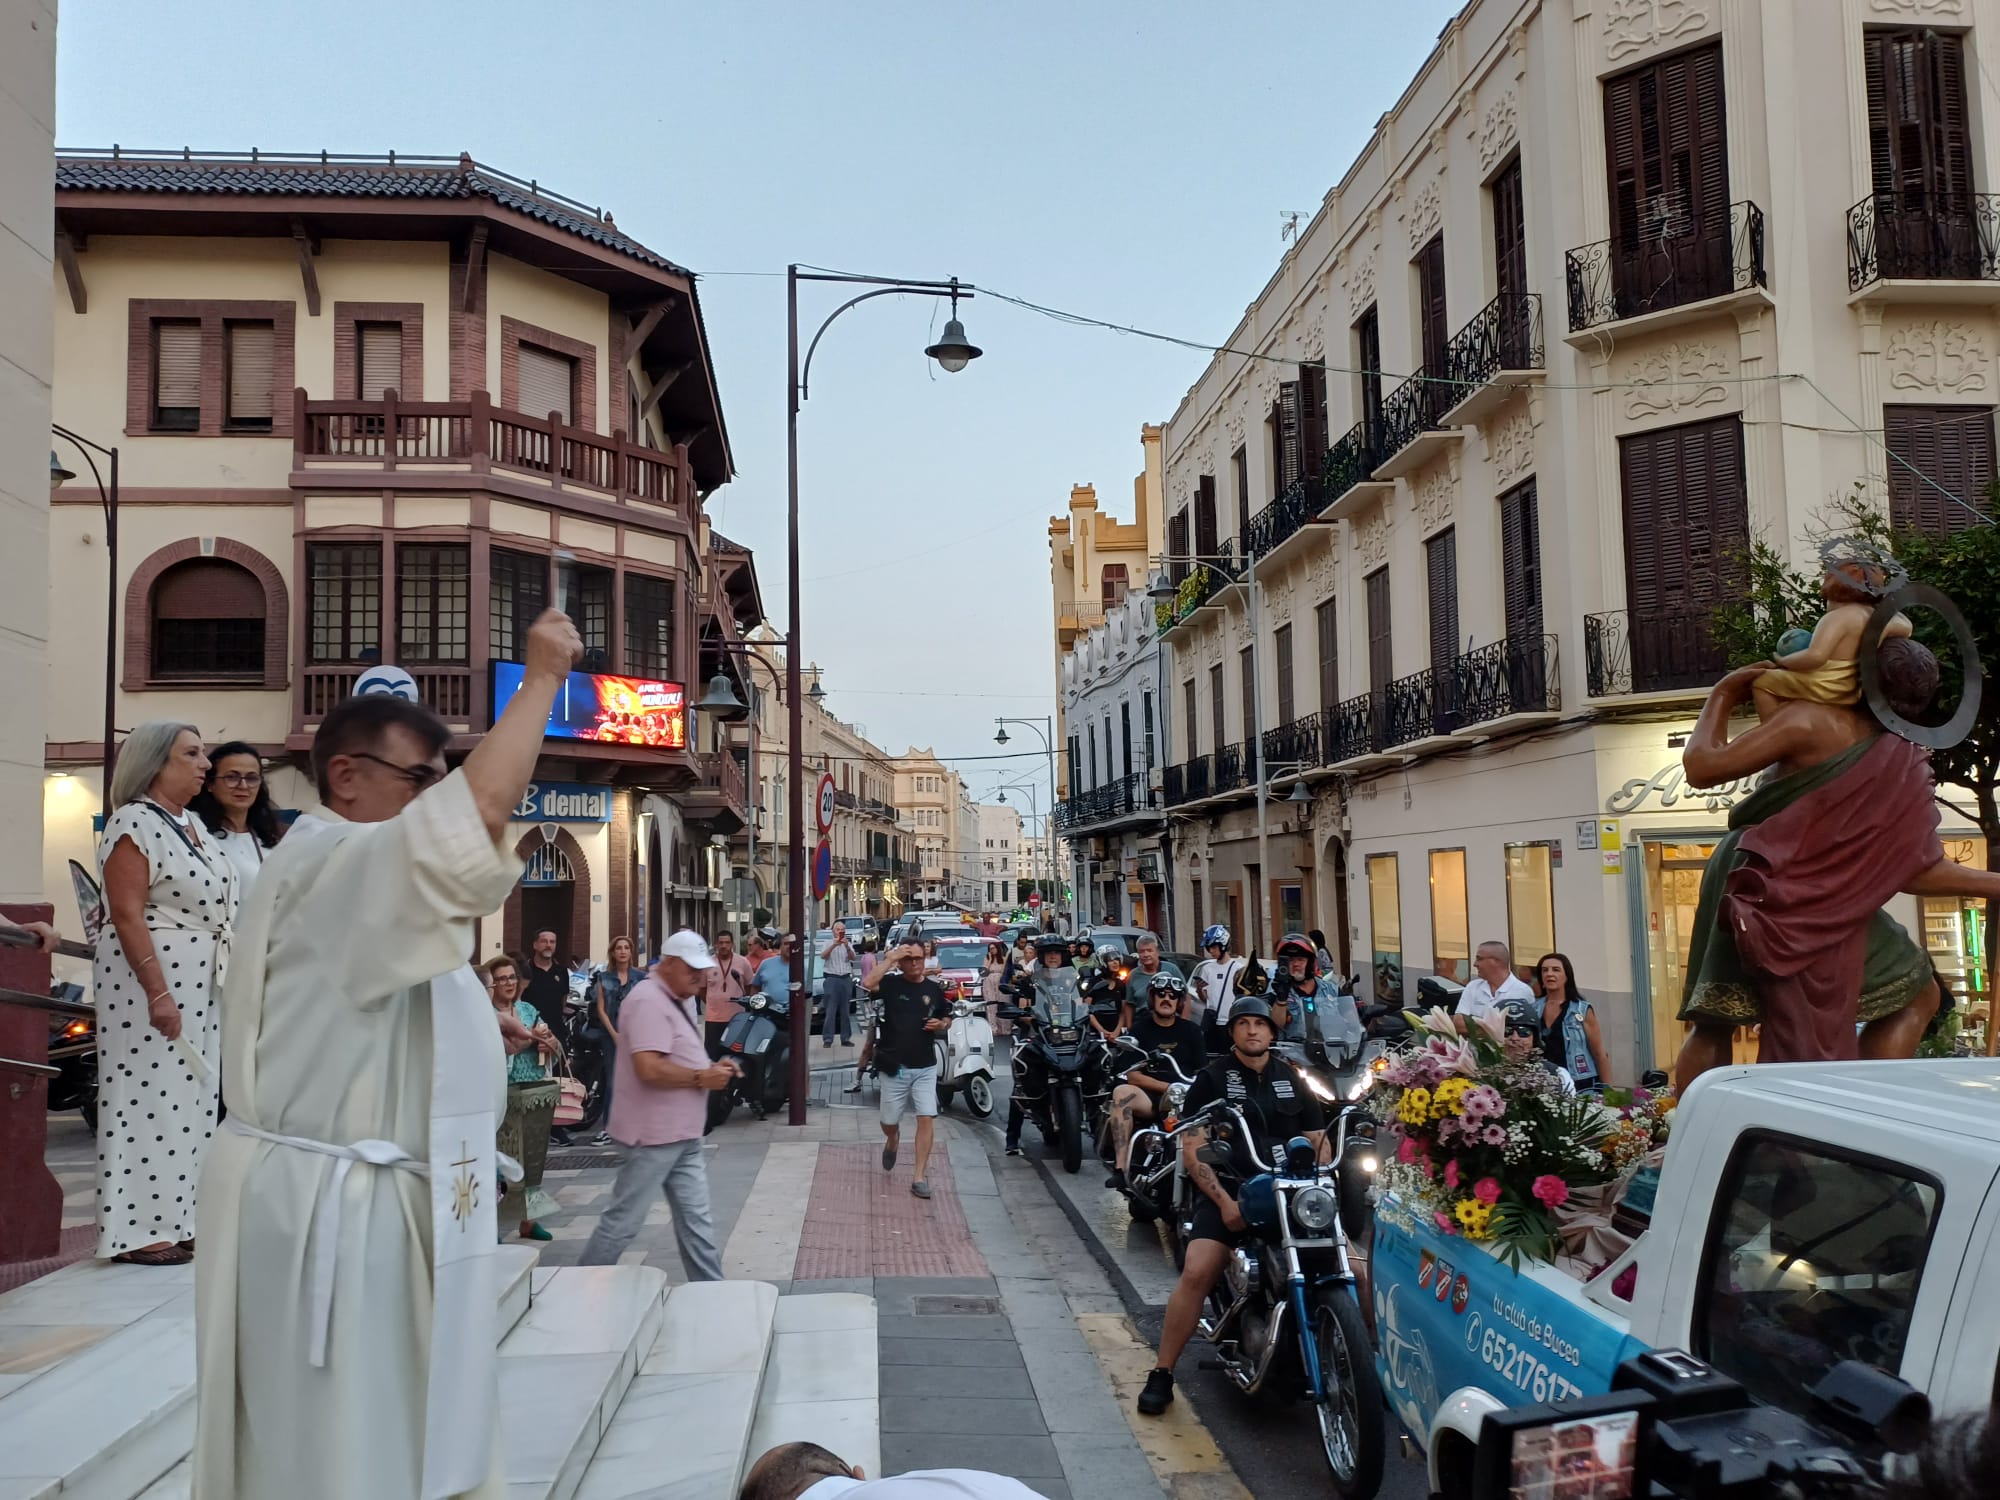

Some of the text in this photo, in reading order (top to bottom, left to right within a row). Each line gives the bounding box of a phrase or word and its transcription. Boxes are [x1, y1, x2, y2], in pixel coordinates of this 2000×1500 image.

[543, 789, 606, 817] dental
[823, 792, 833, 812] 20
[1493, 1293, 1580, 1367] tu club de Buceo
